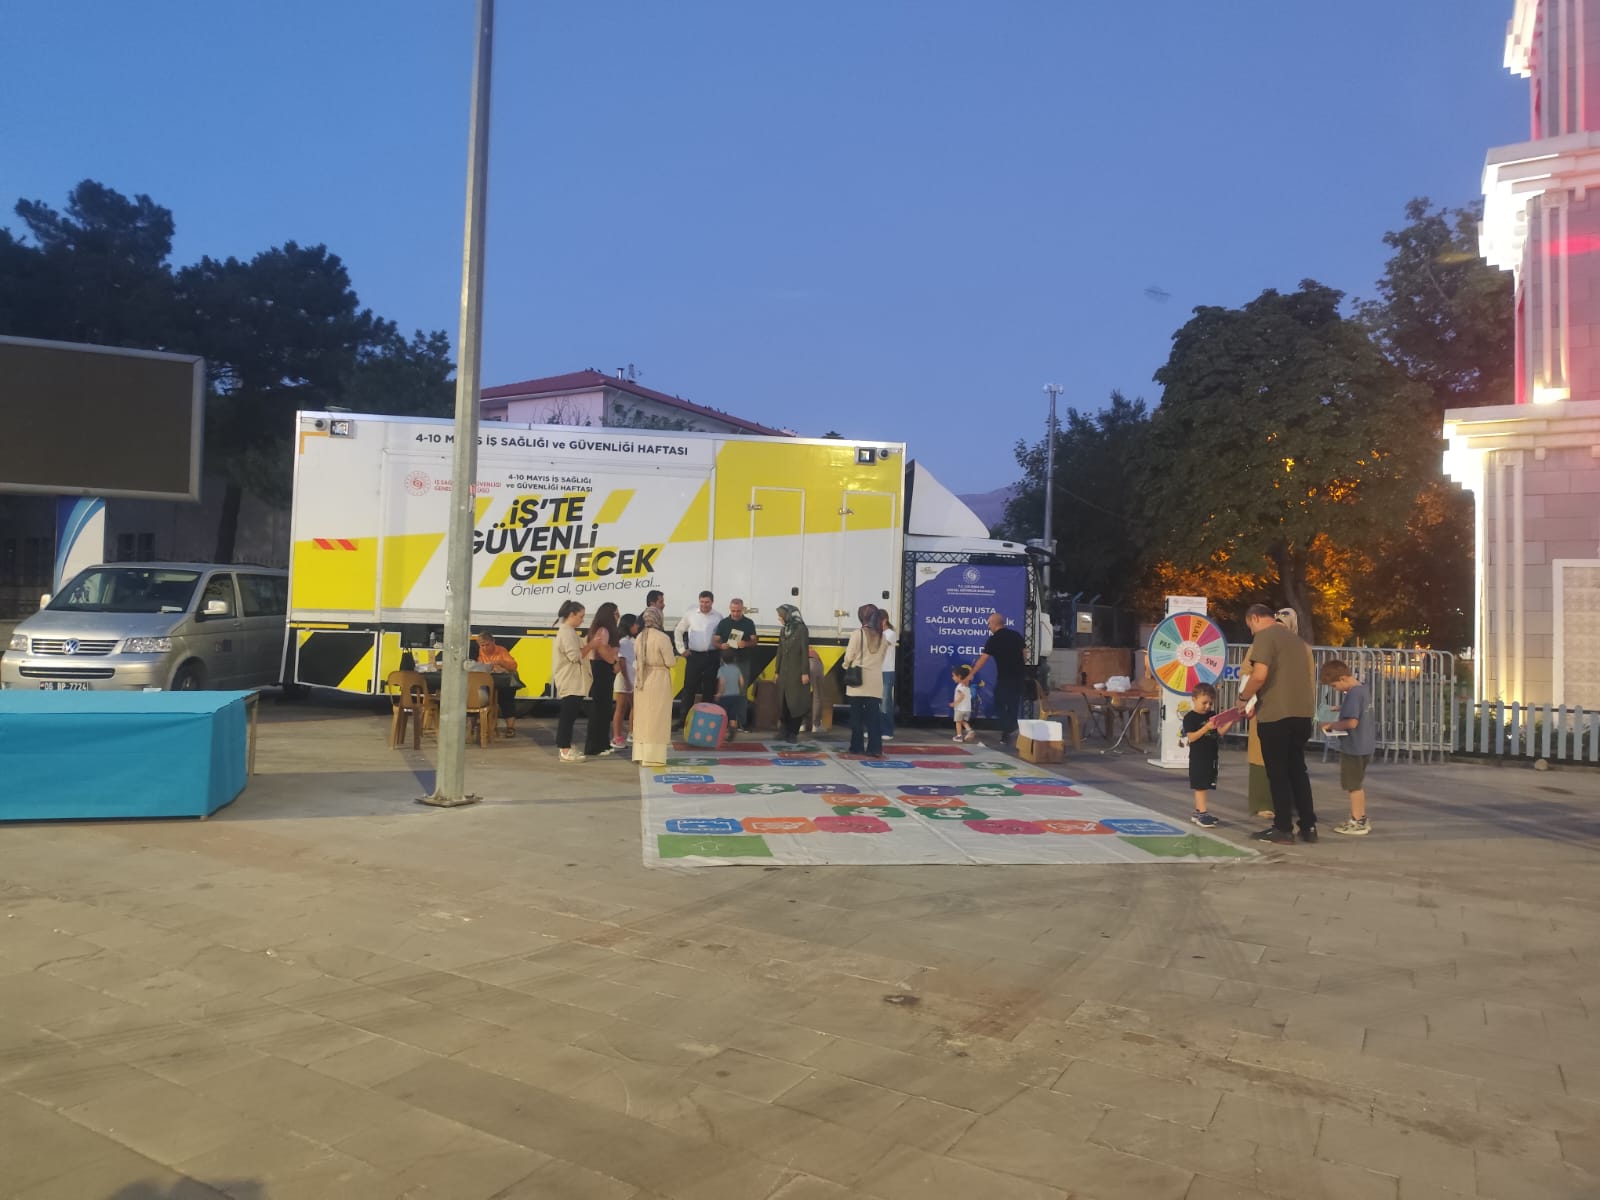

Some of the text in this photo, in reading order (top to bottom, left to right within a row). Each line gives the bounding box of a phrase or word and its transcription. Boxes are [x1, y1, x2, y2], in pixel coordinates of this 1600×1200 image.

[416, 433, 442, 444] 4-10
[486, 434, 498, 447] İŞ
[501, 436, 549, 449] SAĞLIĞI
[552, 441, 566, 449] ve
[569, 439, 634, 453] GÜVENLİĞİ
[638, 444, 688, 456] HAFTASI
[561, 476, 592, 484] SAĞLIĞI
[516, 482, 559, 491] GÜVENLİĞİ
[510, 548, 658, 581] GELECEK
[511, 583, 554, 597] Önlem
[557, 584, 572, 596] al,
[575, 580, 632, 596] güvende
[942, 605, 972, 614] GÜVEN
[925, 616, 956, 625] SAĞLIK
[958, 617, 969, 625] VE
[938, 626, 995, 637] İSTASYONU'N
[1159, 640, 1172, 649] PAS
[930, 645, 954, 657] HOŞ
[1206, 658, 1218, 667] PAS
